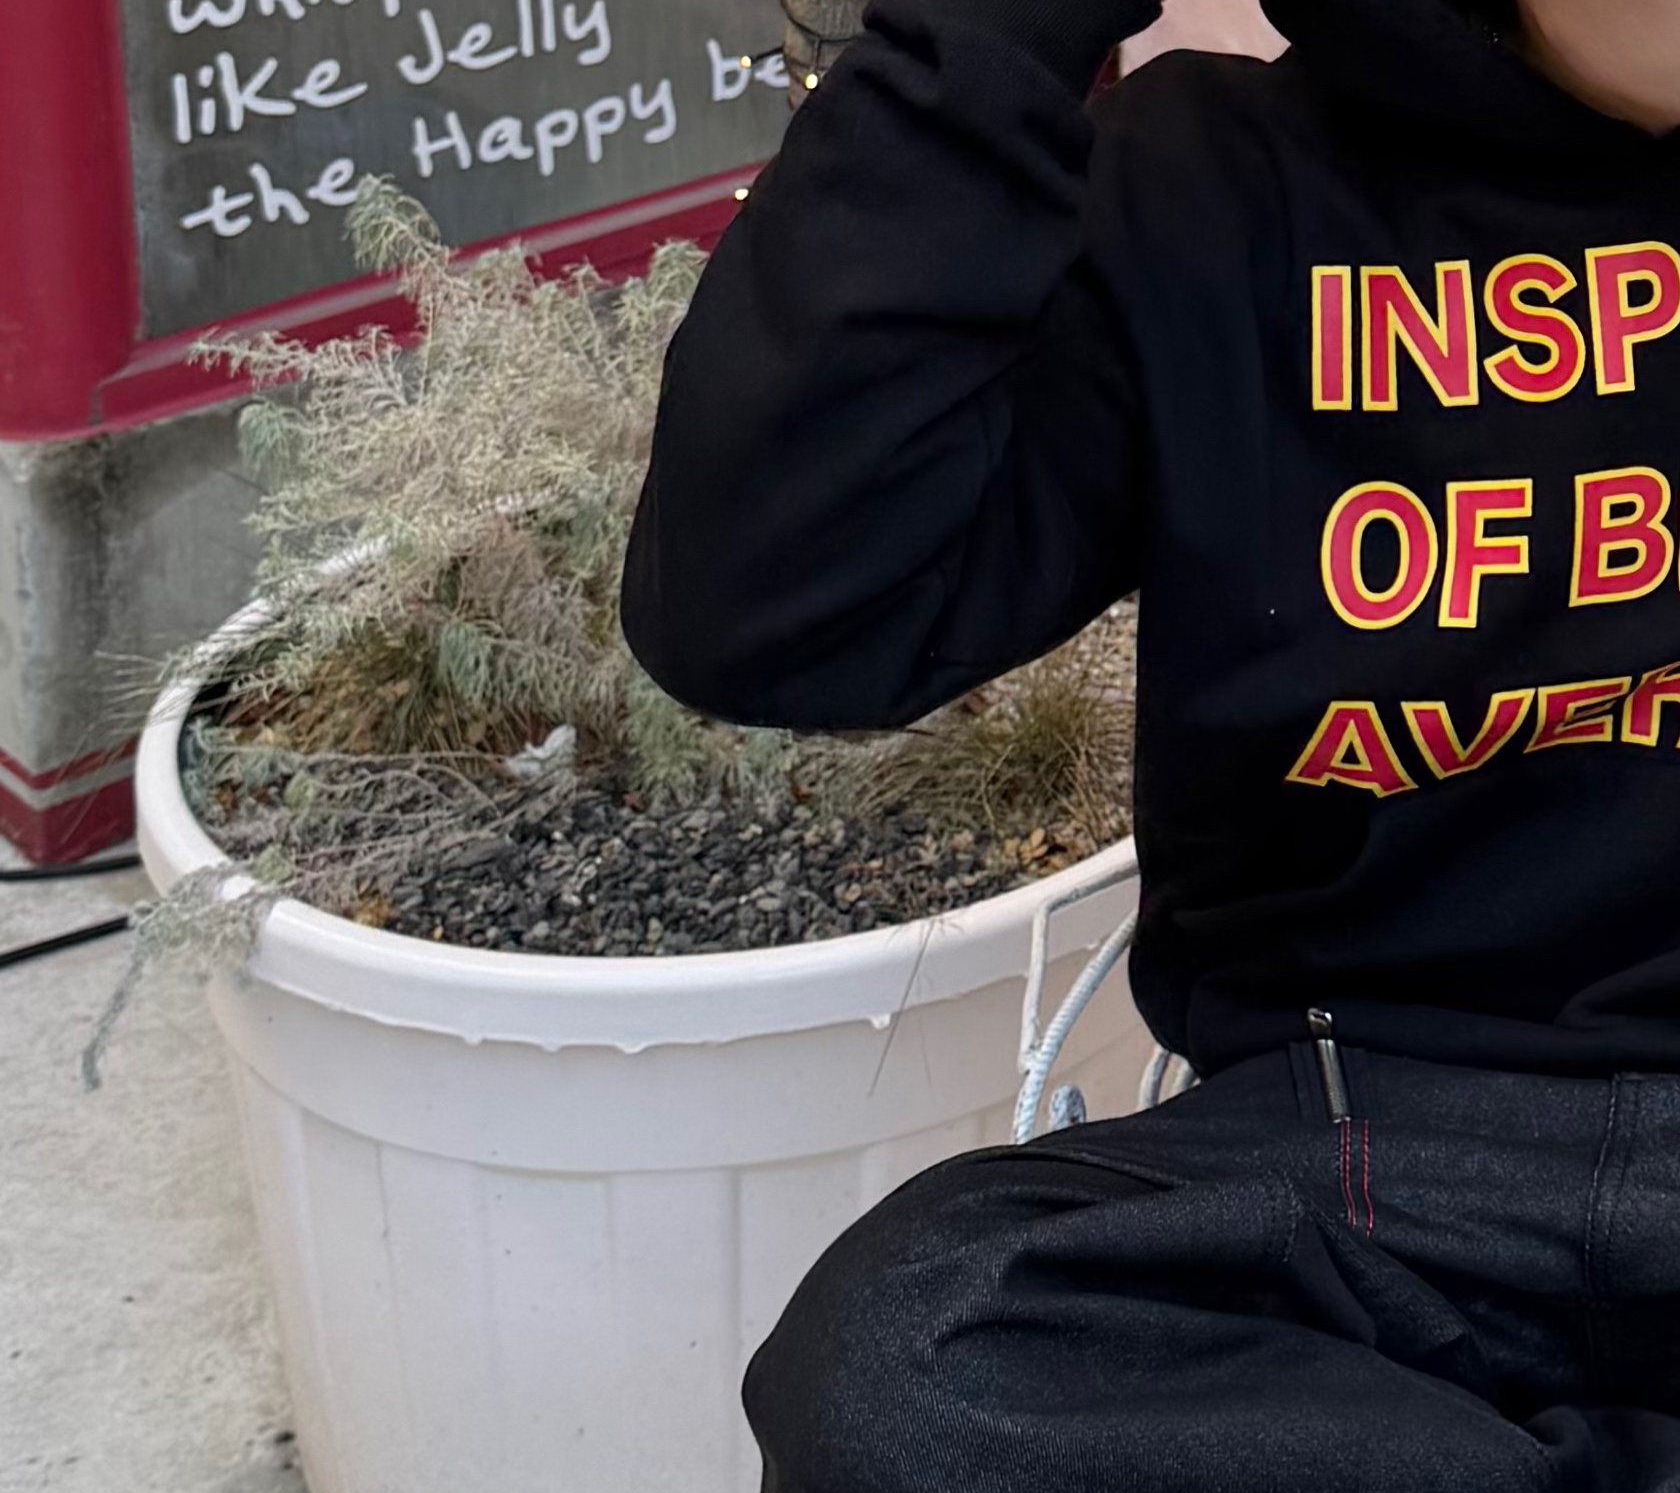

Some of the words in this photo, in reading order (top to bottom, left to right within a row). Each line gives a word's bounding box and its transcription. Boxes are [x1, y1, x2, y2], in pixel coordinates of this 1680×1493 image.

[180, 158, 356, 237] the
[411, 79, 677, 177] Happy
[1320, 480, 1533, 630] OF
